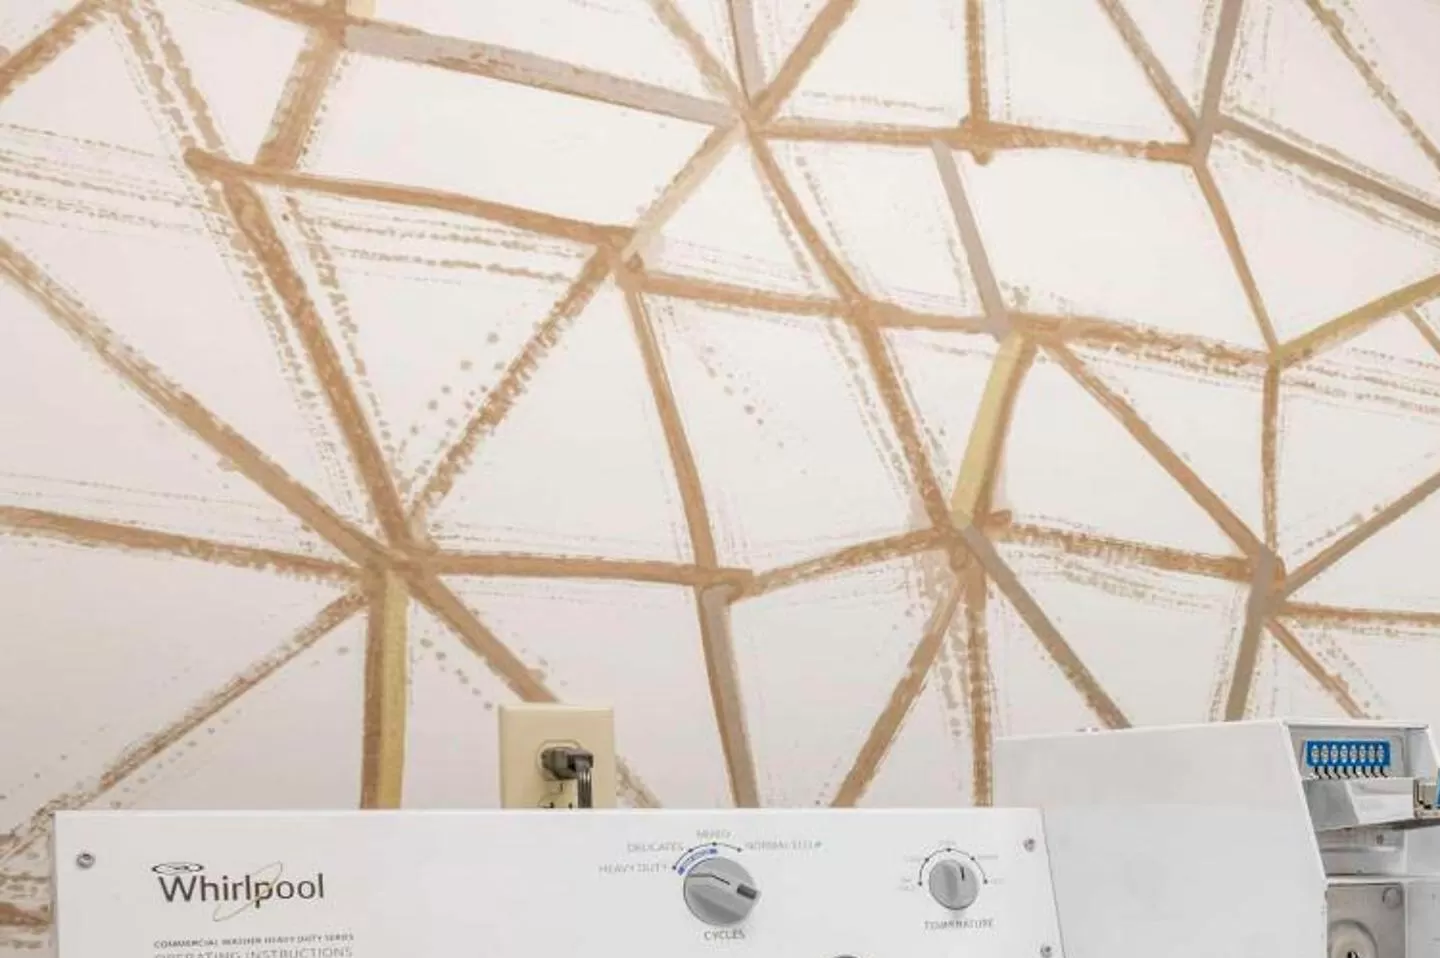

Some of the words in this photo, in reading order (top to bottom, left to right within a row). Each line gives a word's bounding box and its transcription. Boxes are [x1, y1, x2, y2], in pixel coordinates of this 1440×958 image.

[158, 873, 325, 909] Whirlpool
[153, 938, 219, 949] COMMERCIAL
[297, 934, 322, 944] DUTY
[324, 933, 354, 943] SERIES
[704, 929, 745, 941] CYCLES
